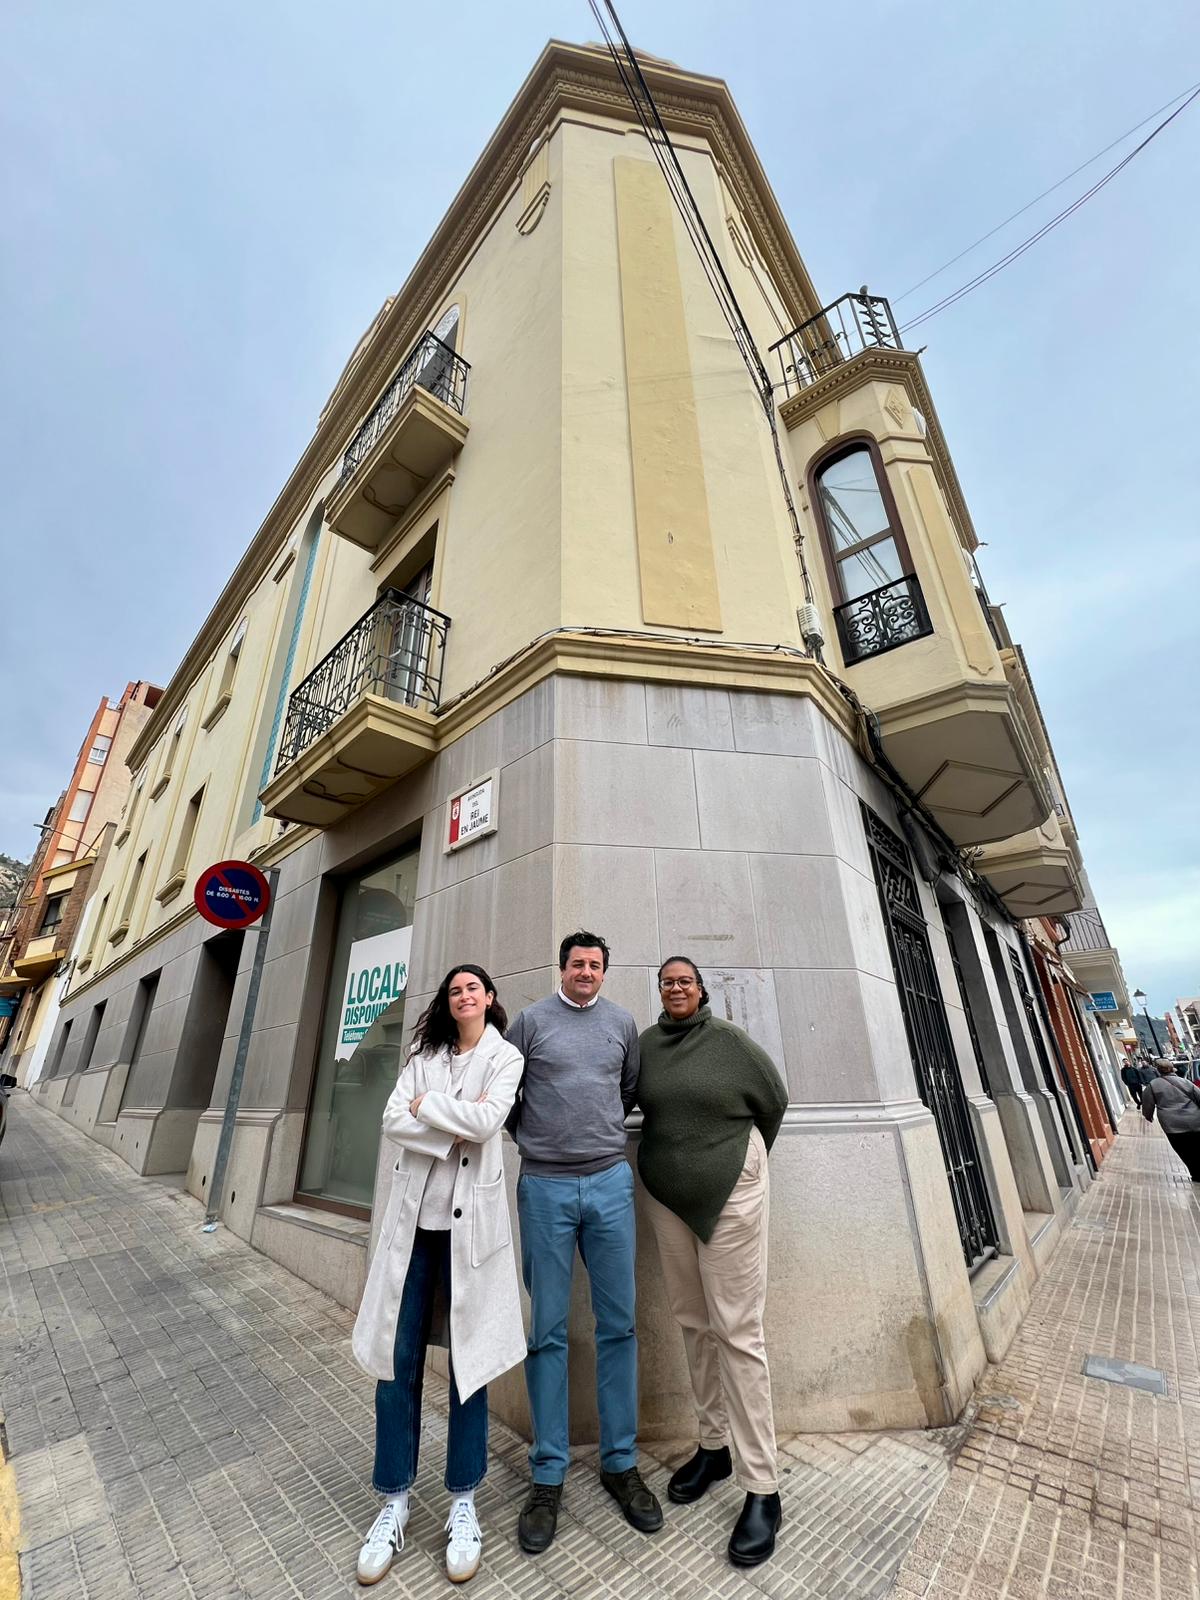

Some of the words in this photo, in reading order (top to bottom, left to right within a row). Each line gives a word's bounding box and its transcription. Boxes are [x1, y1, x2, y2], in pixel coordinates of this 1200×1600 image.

[461, 824, 468, 835] EN
[469, 814, 488, 831] JAUME
[470, 809, 480, 820] REI
[347, 962, 402, 1004] LOCAL
